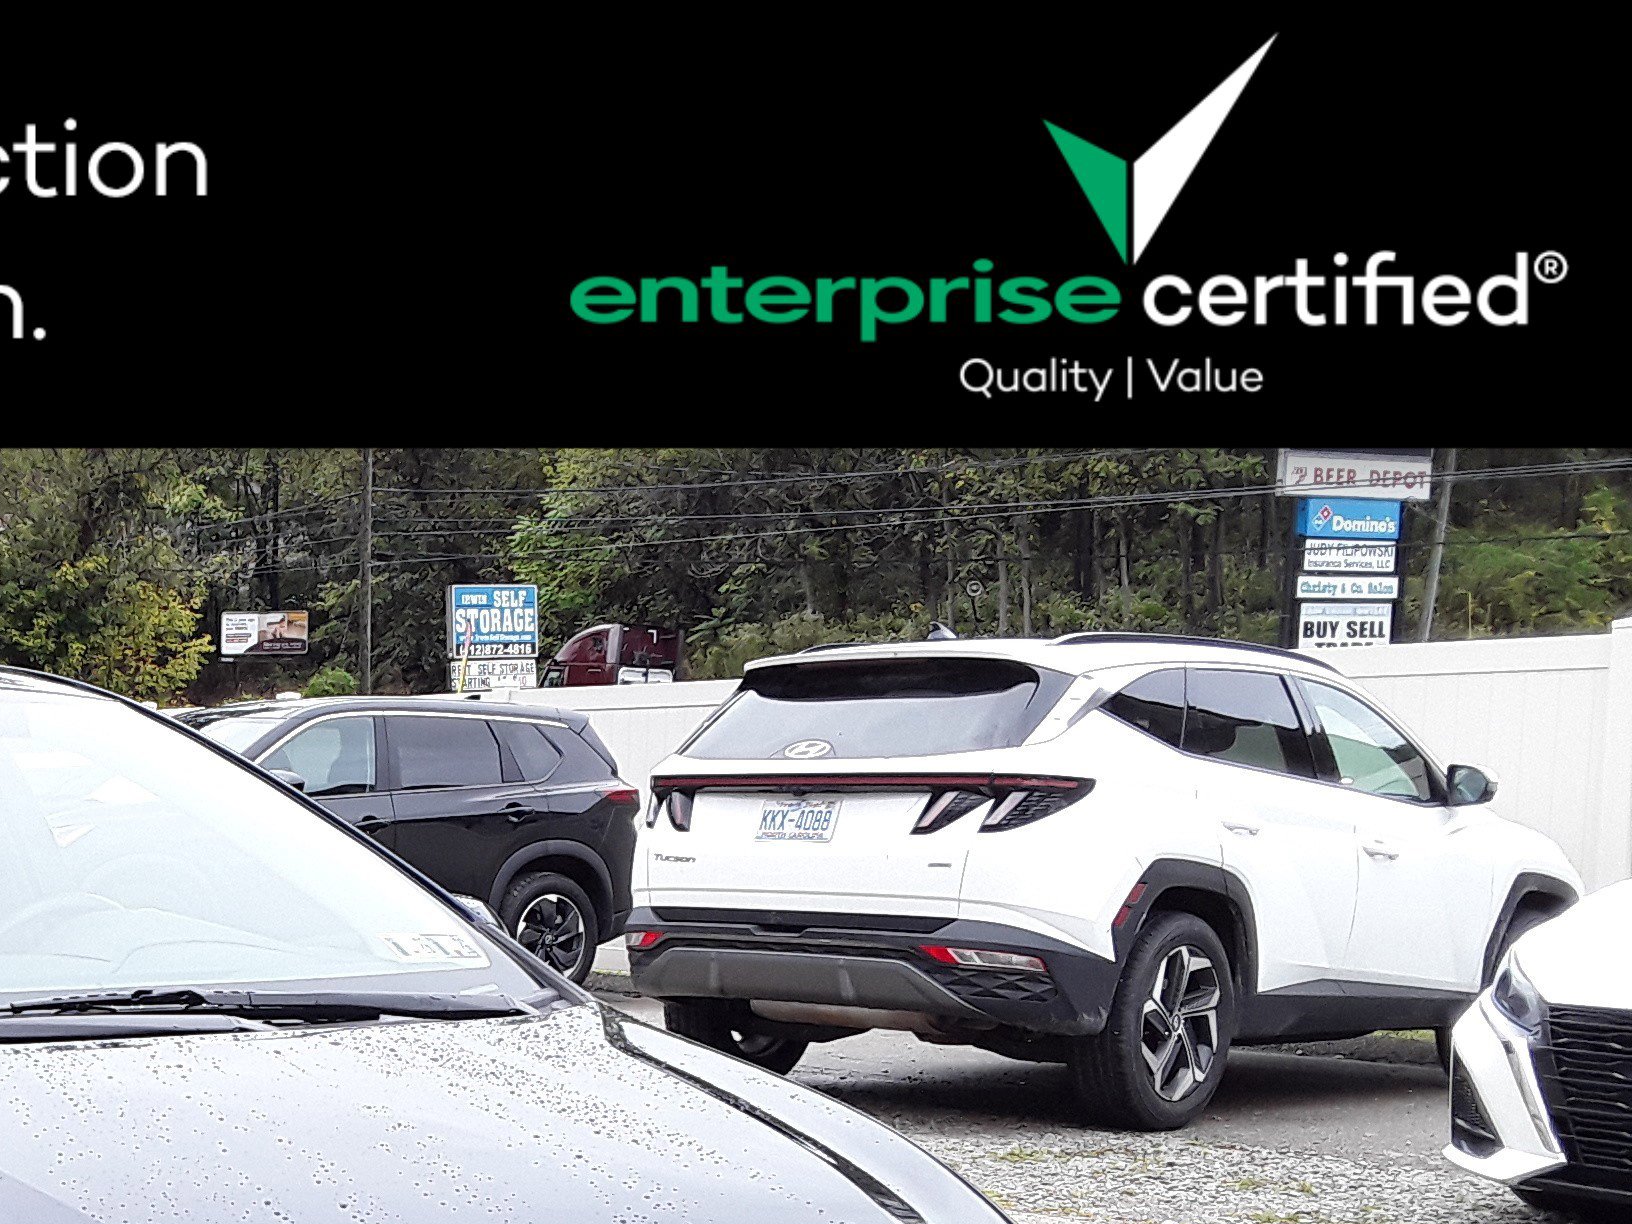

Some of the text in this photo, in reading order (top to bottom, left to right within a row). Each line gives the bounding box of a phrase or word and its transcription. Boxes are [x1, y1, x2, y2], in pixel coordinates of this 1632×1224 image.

[1313, 467, 1356, 485] BEER
[1370, 470, 1426, 488] DEPOT
[1332, 515, 1395, 533] Domino's
[1376, 560, 1390, 568] LLC
[493, 590, 527, 607] SELF
[455, 608, 534, 634] STORAGE
[1303, 621, 1385, 638] BUY SELL
[452, 665, 471, 676] RET
[478, 664, 496, 675] SELF
[759, 809, 832, 831] KKX-4088
